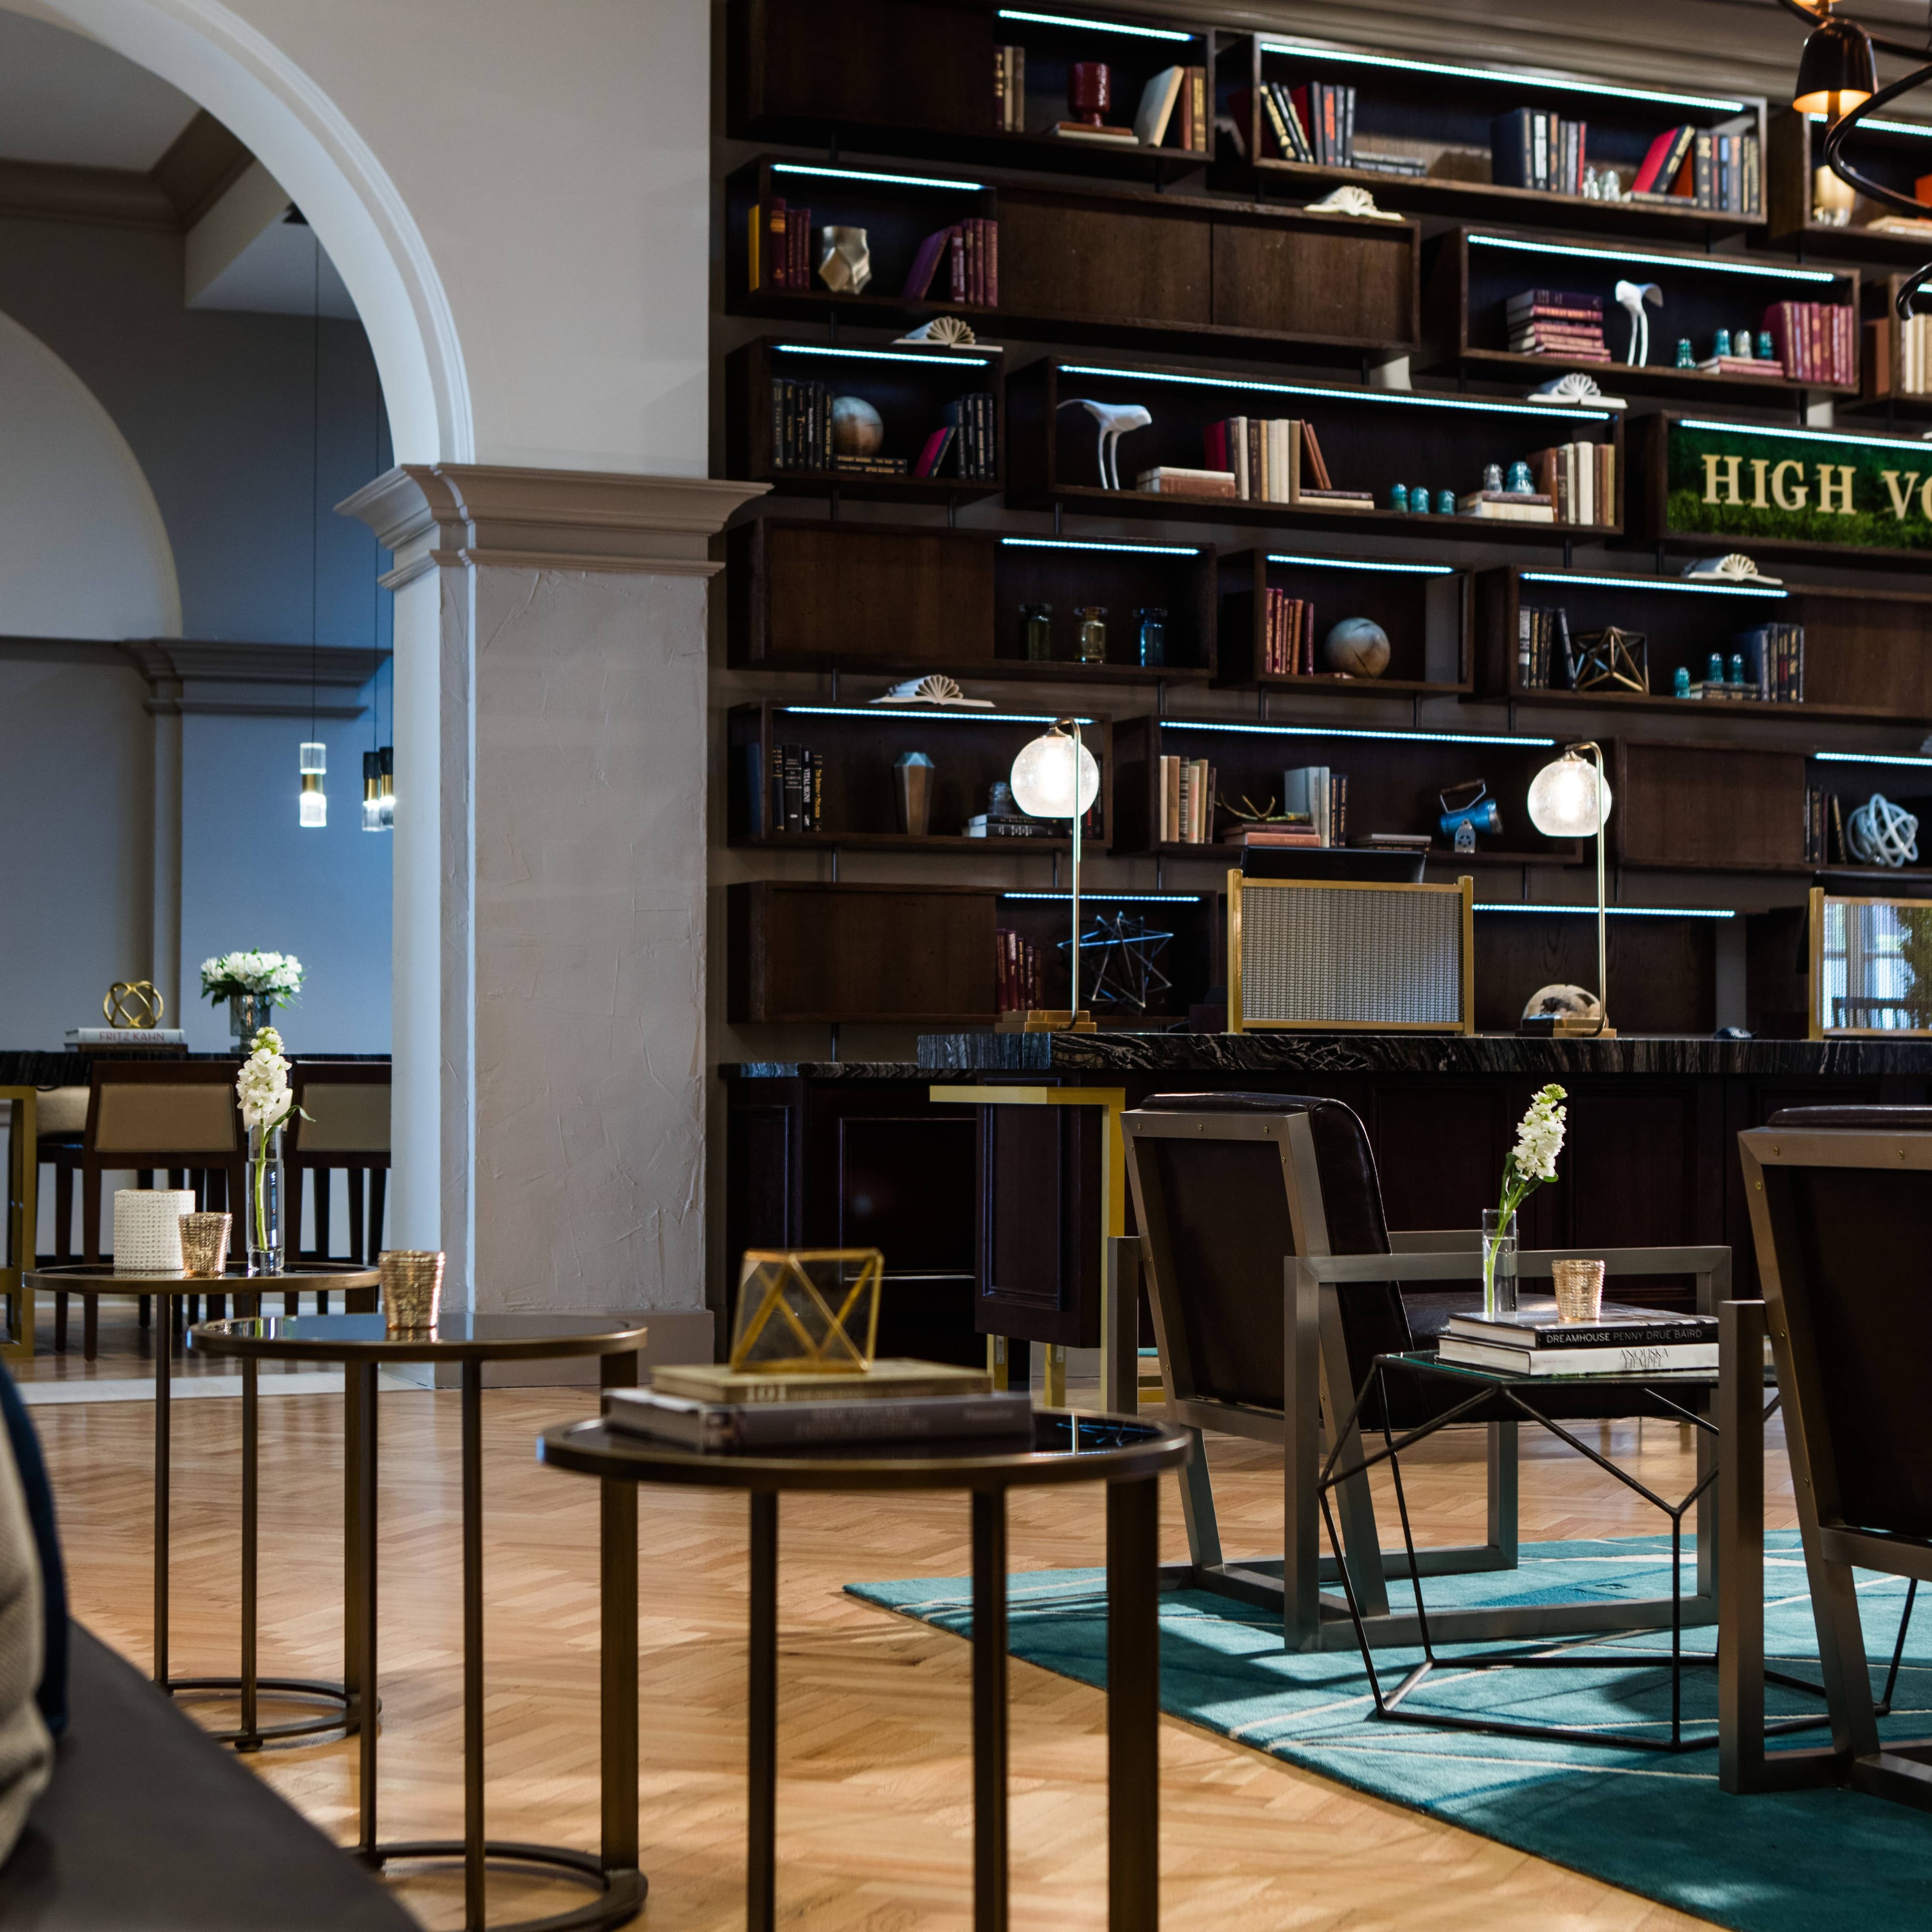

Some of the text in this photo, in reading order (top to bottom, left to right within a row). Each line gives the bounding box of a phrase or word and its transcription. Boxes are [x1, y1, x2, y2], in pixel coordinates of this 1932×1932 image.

[1701, 453, 1857, 515] HIGH
[99, 1032, 165, 1041] FRITZ KAHN
[1546, 1329, 1702, 1344] DREAMHOUSE PENNY DRUE BAIRD
[1620, 1348, 1669, 1359] ANOUSKA
